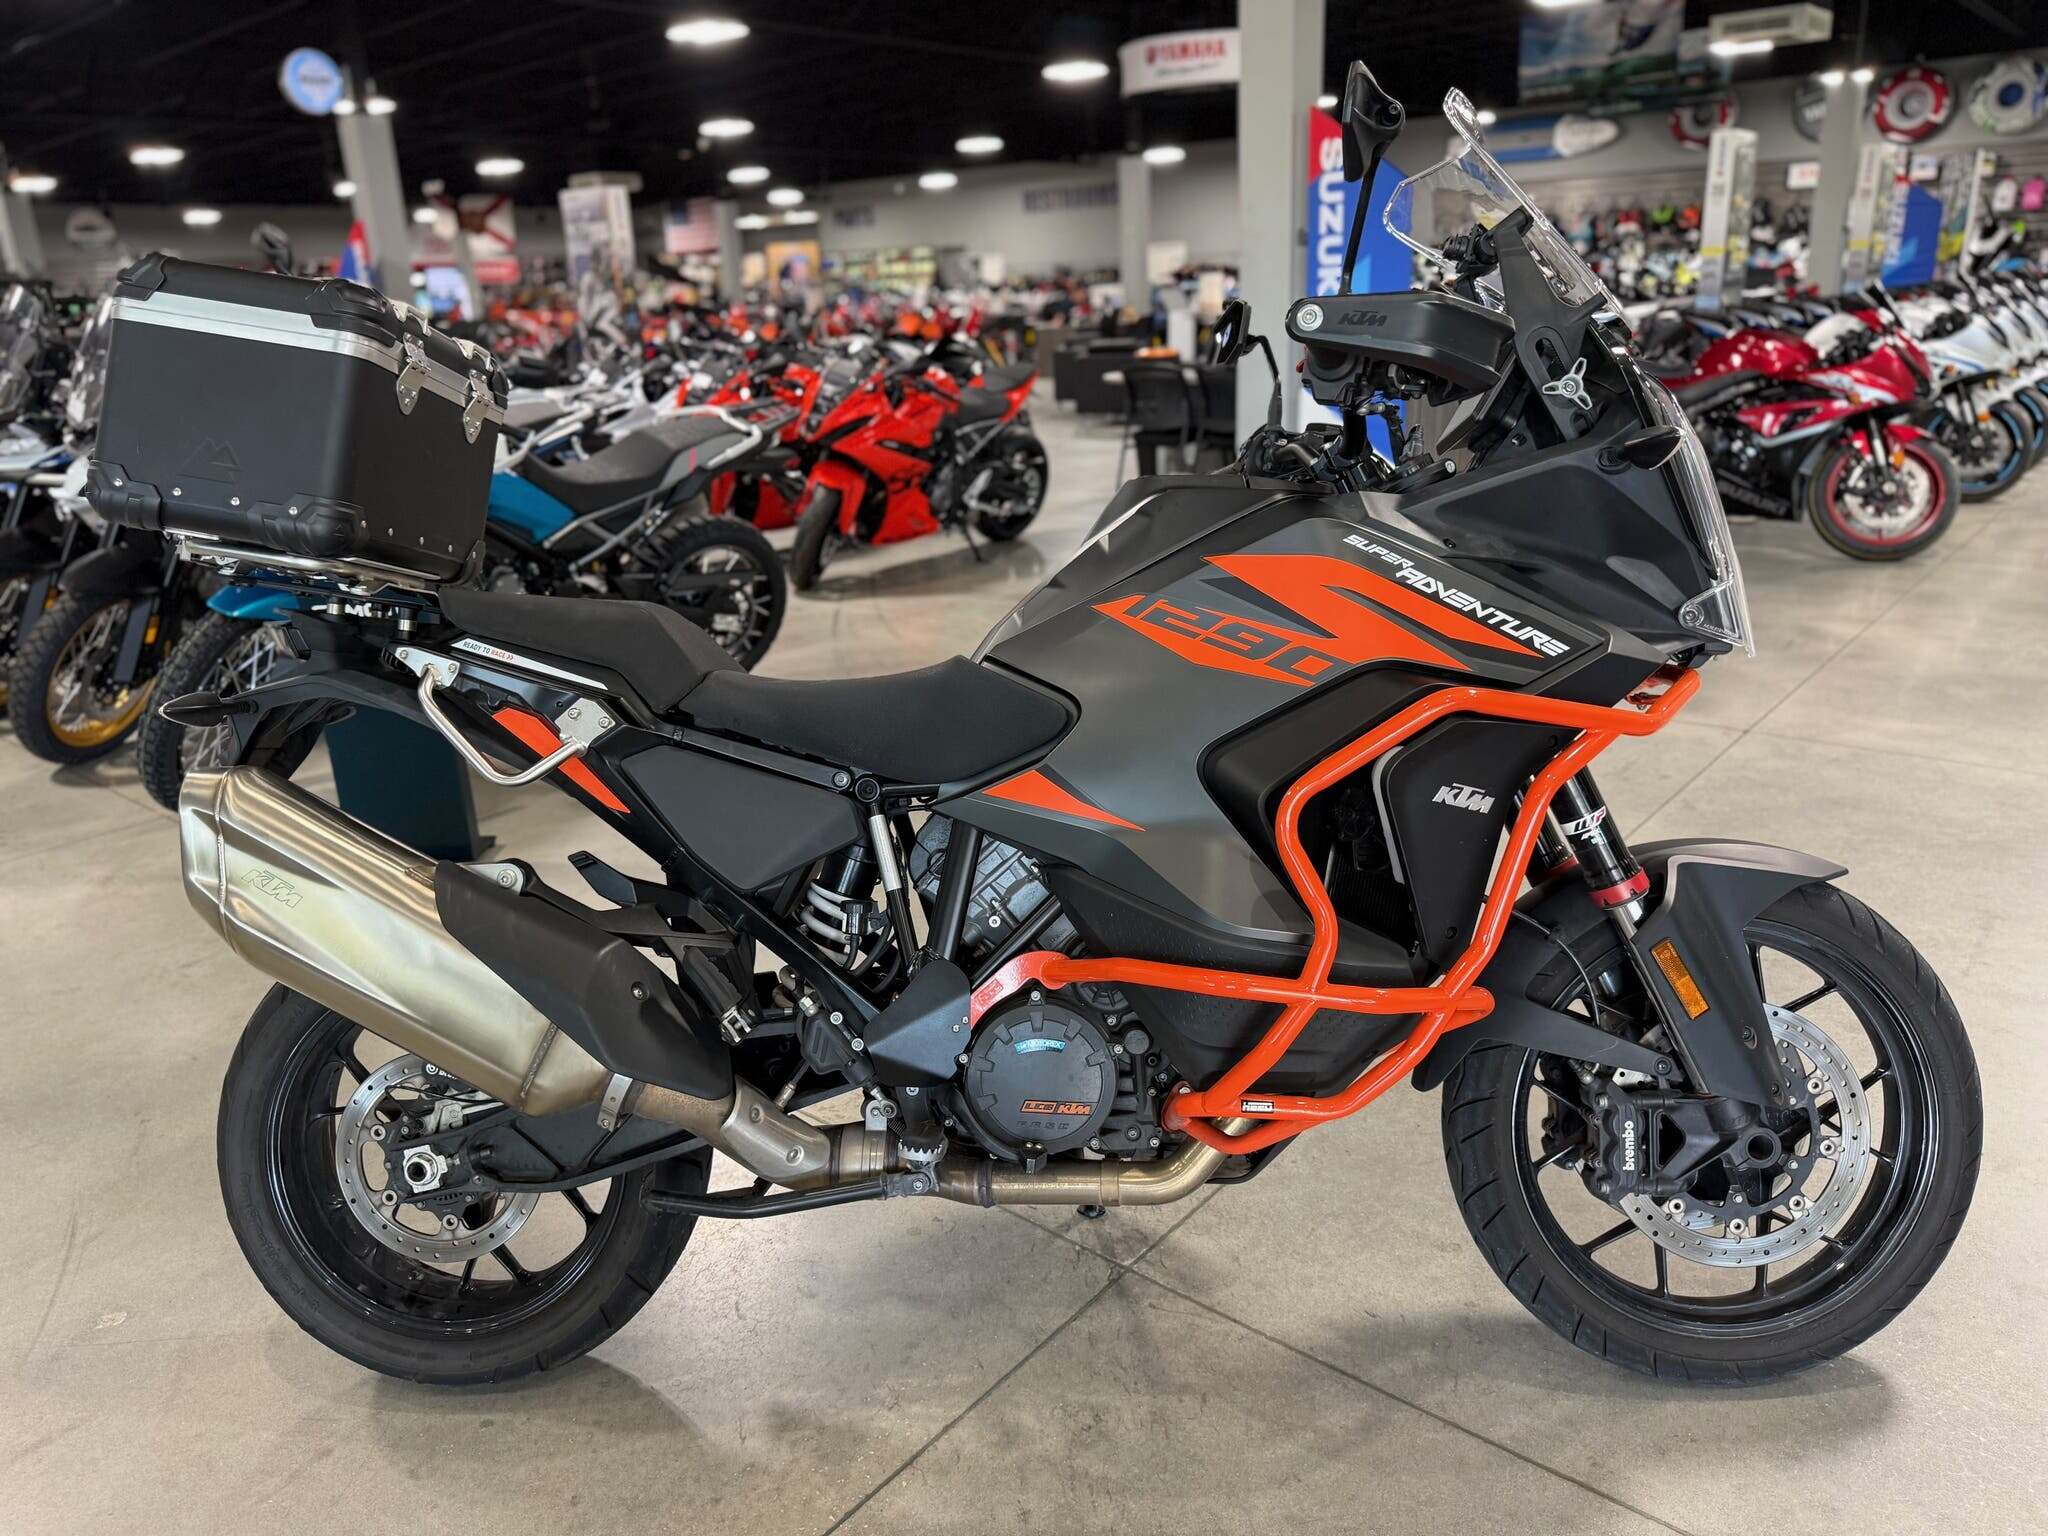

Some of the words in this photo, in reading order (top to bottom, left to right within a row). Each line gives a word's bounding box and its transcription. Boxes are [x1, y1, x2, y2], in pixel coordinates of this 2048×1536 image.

[1317, 137, 1344, 297] SUZUK
[1338, 309, 1388, 327] KTM
[1342, 534, 1415, 569] SUPER
[1395, 567, 1571, 658] ADVENTURE
[462, 640, 481, 653] READY
[483, 647, 491, 655] TO
[1122, 593, 1351, 685] 1290
[1431, 782, 1496, 814] KTM
[241, 868, 304, 908] KTM
[1056, 1101, 1091, 1115] KTM
[1621, 1120, 1636, 1171] brembo
